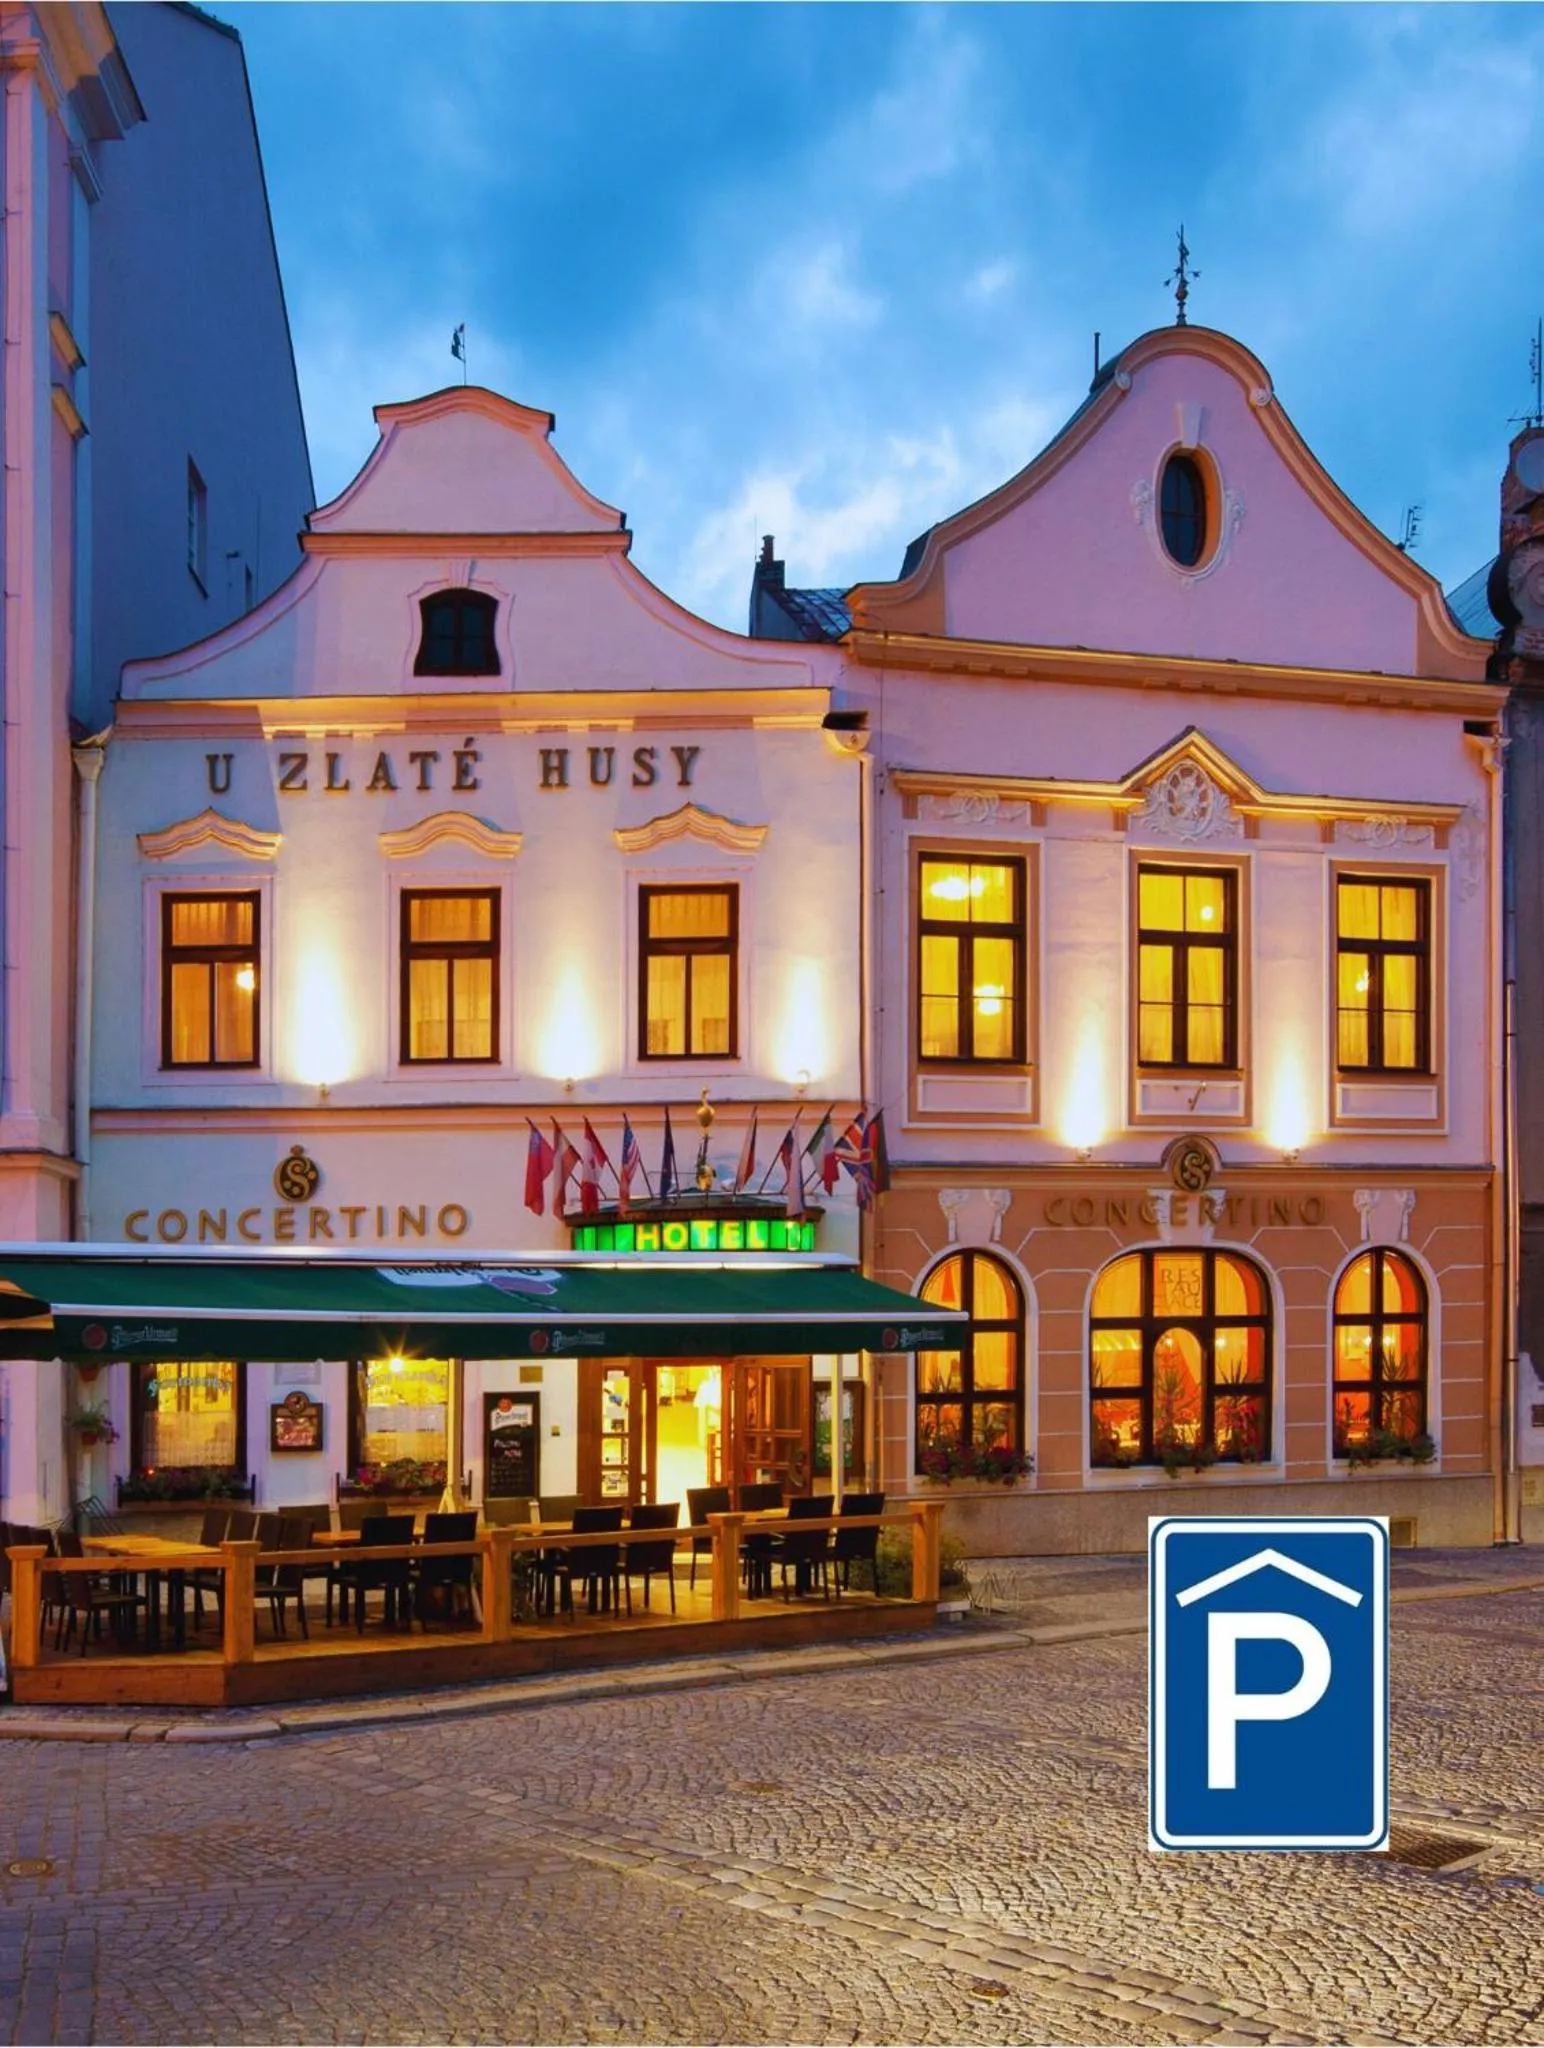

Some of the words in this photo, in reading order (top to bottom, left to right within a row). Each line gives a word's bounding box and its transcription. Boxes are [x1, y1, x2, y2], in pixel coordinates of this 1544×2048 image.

[206, 753, 235, 793] U
[278, 737, 480, 791] ZLATÉ
[538, 746, 700, 788] HUSY
[124, 1203, 469, 1243] CONCERTINO
[1043, 1195, 1326, 1228] CONCERTINO
[635, 1220, 767, 1250] HOTEL
